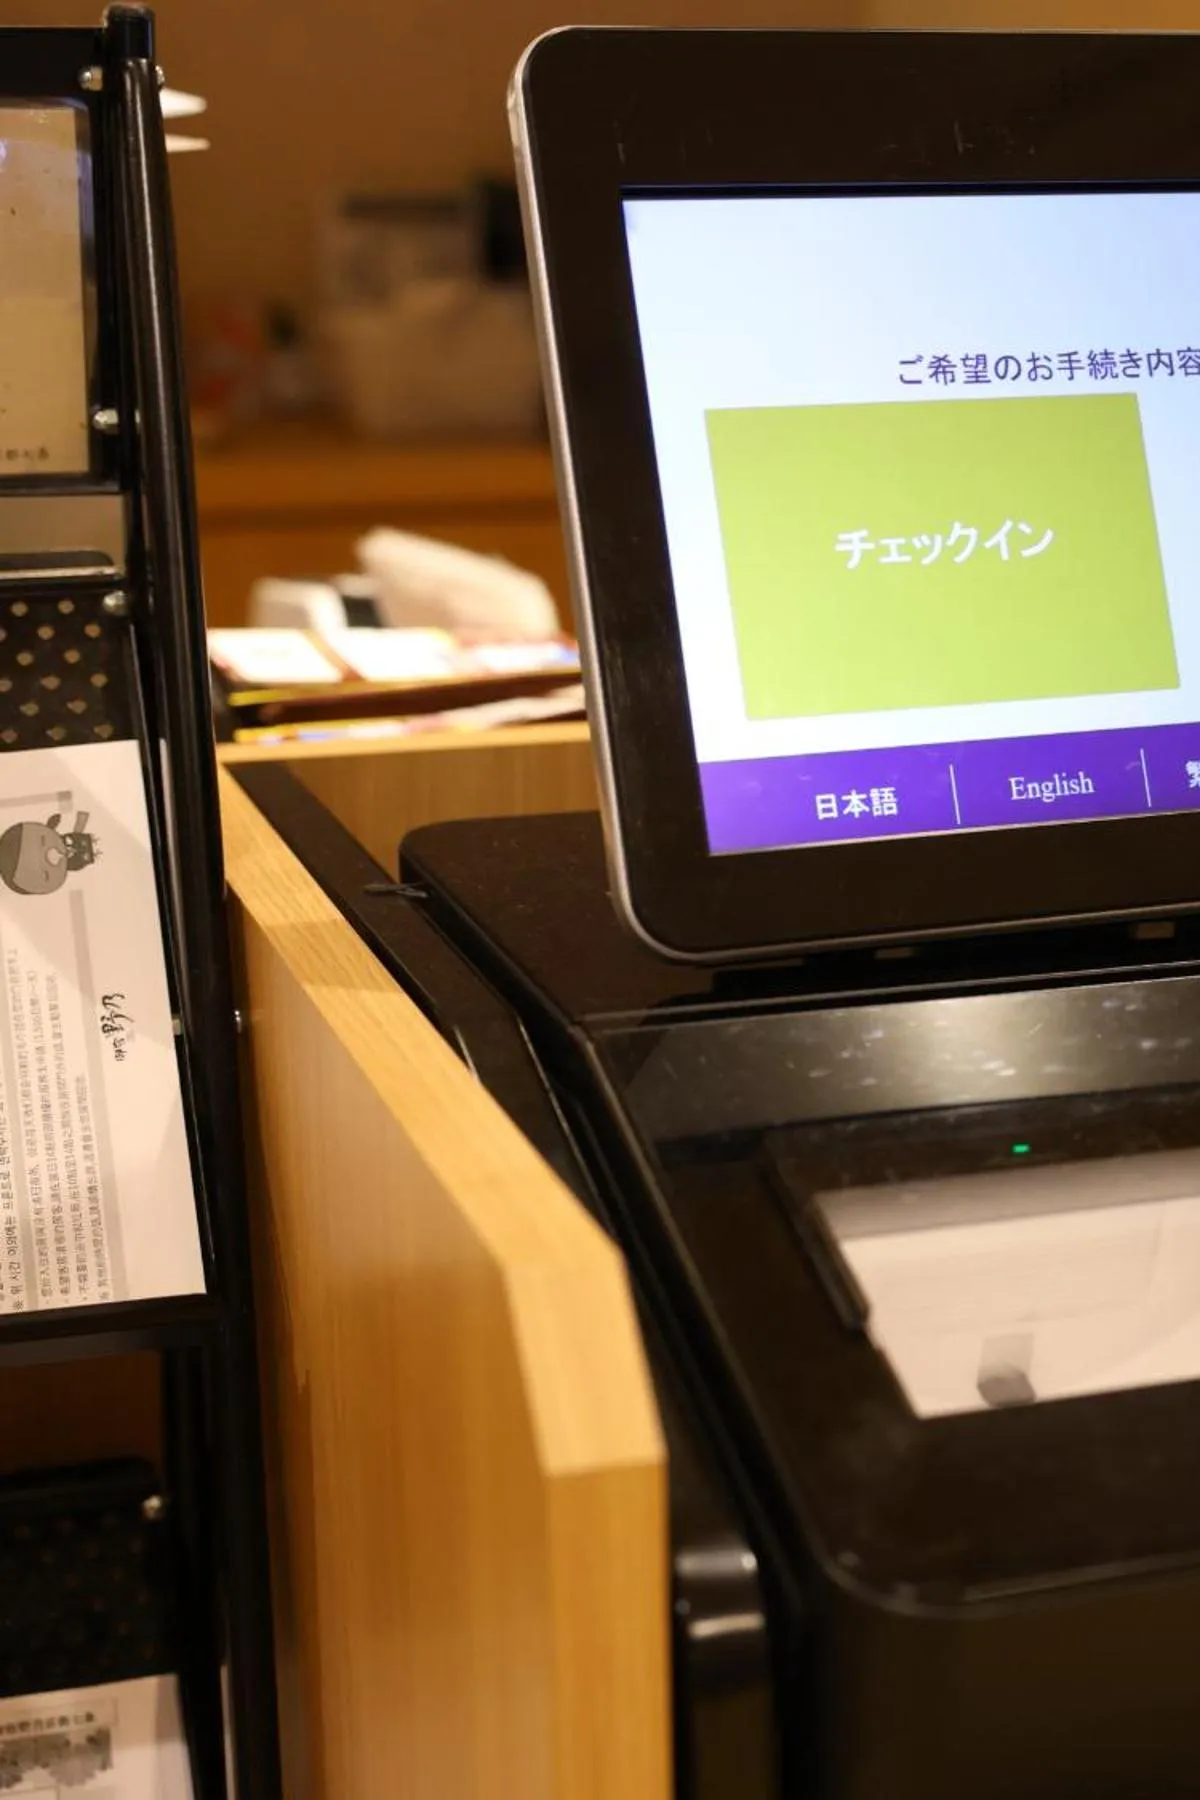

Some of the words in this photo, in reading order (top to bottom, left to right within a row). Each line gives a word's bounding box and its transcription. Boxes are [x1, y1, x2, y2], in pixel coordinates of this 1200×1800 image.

[834, 521, 1053, 569] チェックイン
[815, 787, 898, 820] 日本語
[1008, 771, 1095, 803] English
